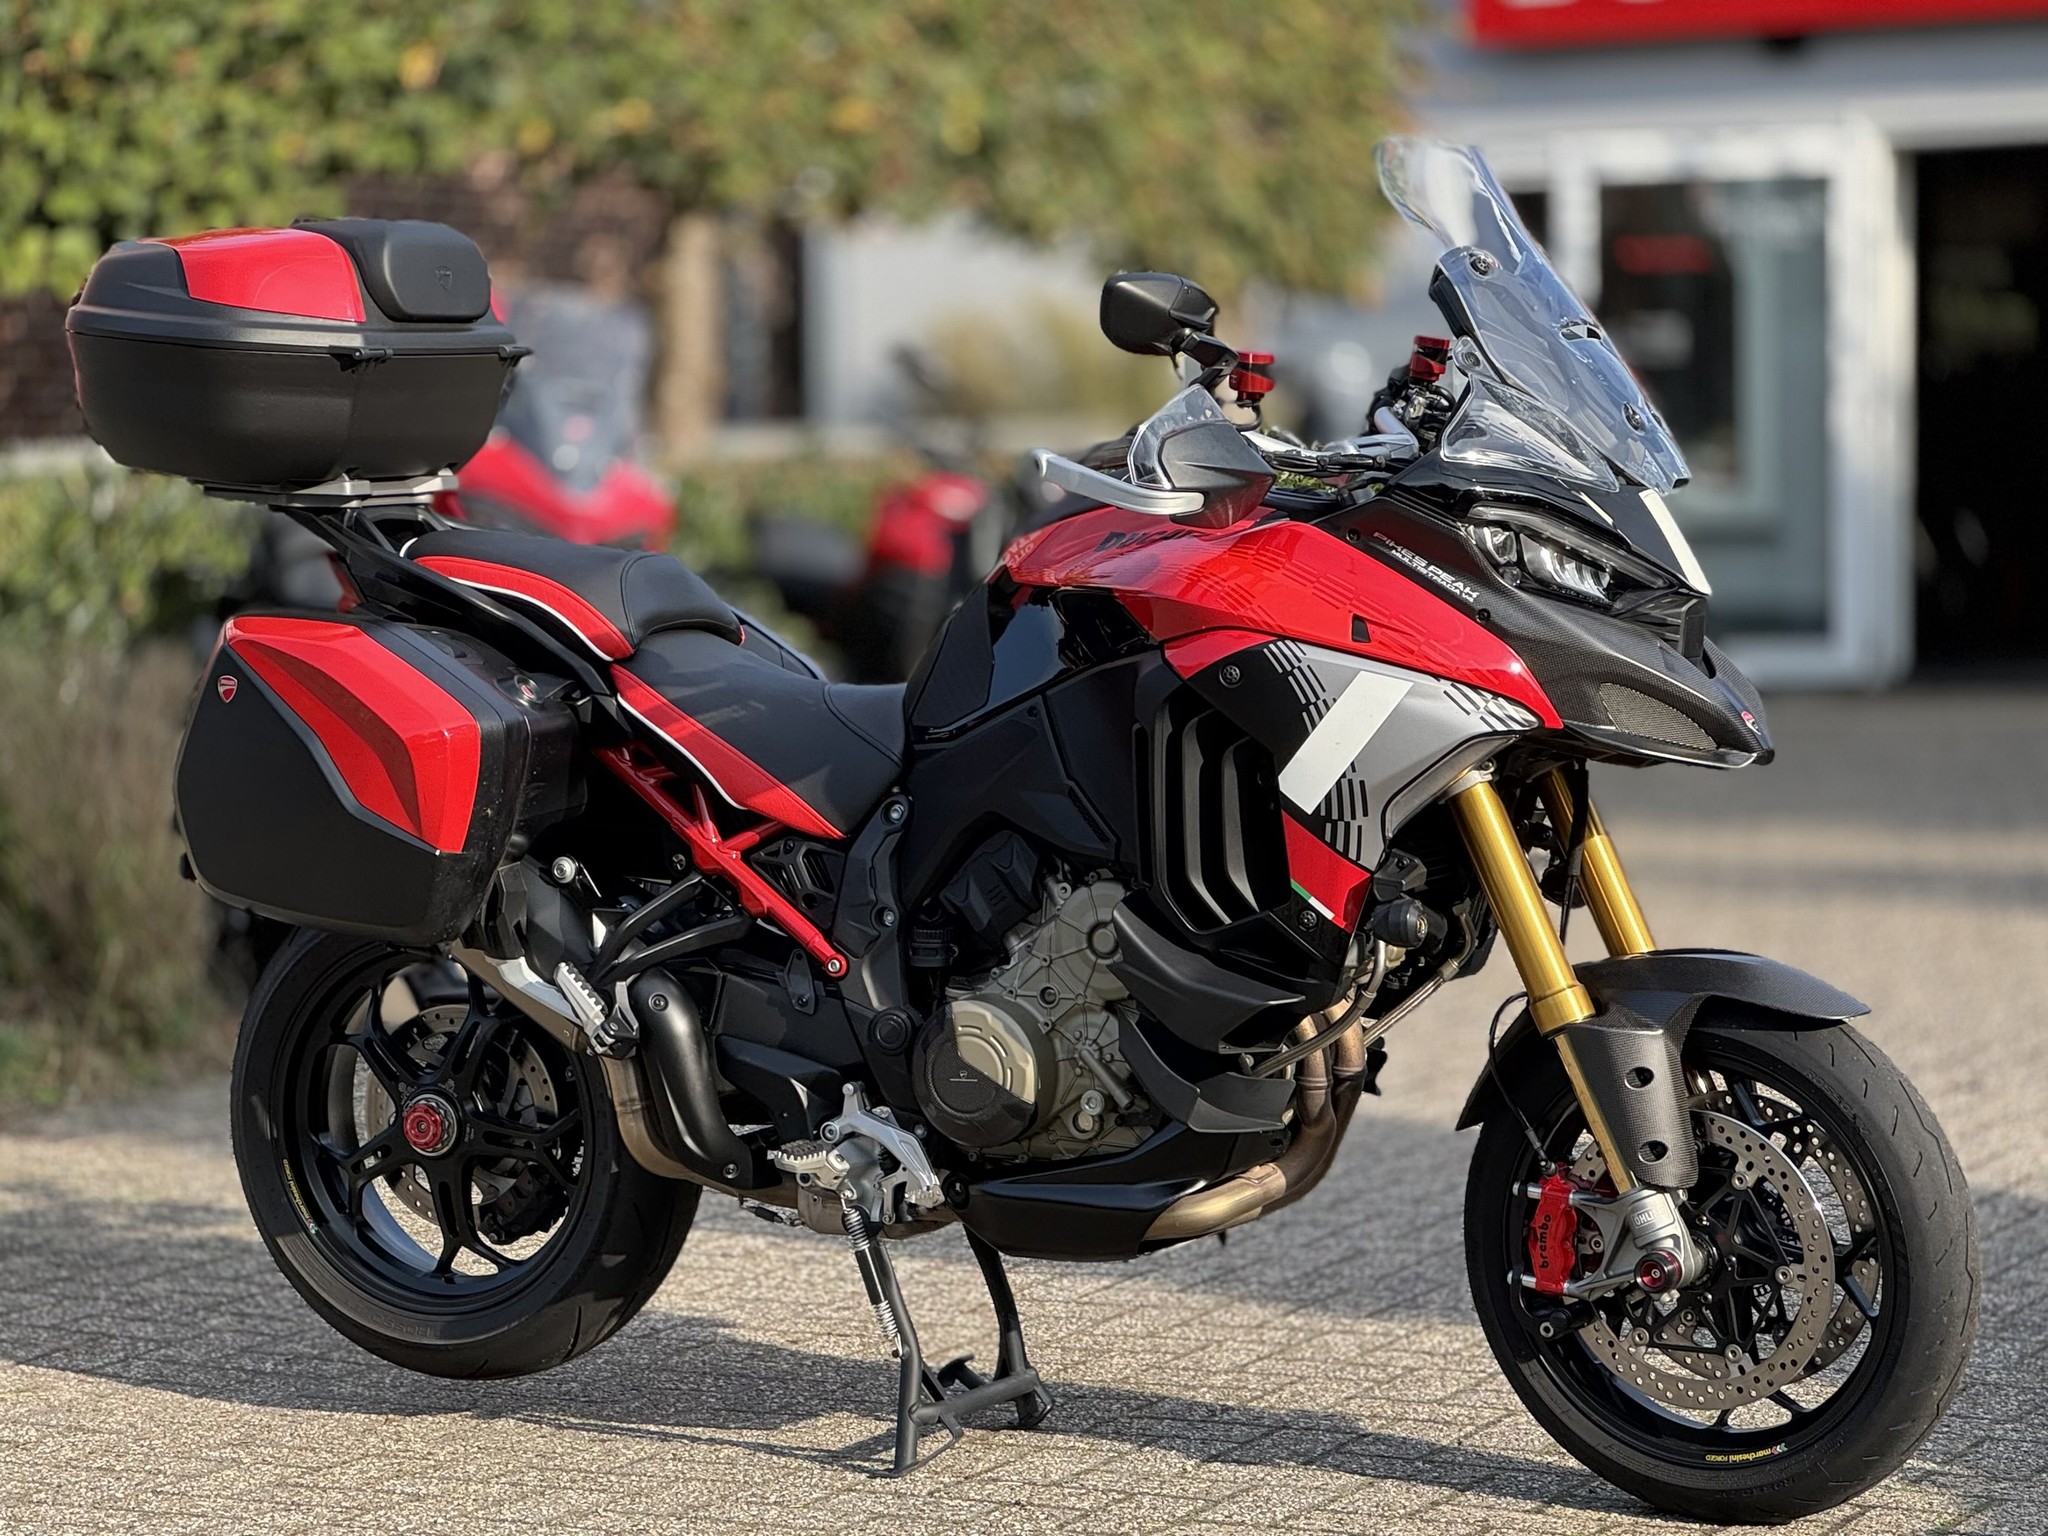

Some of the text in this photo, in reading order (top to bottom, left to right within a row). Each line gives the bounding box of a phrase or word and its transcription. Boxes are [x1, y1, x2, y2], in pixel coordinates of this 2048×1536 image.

[1373, 532, 1479, 599] PIKES PEAK
[1391, 550, 1460, 595] MULTISTRADA
[1539, 1214, 1551, 1269] brembo
[1705, 1448, 1772, 1463] marchesini FORGED
